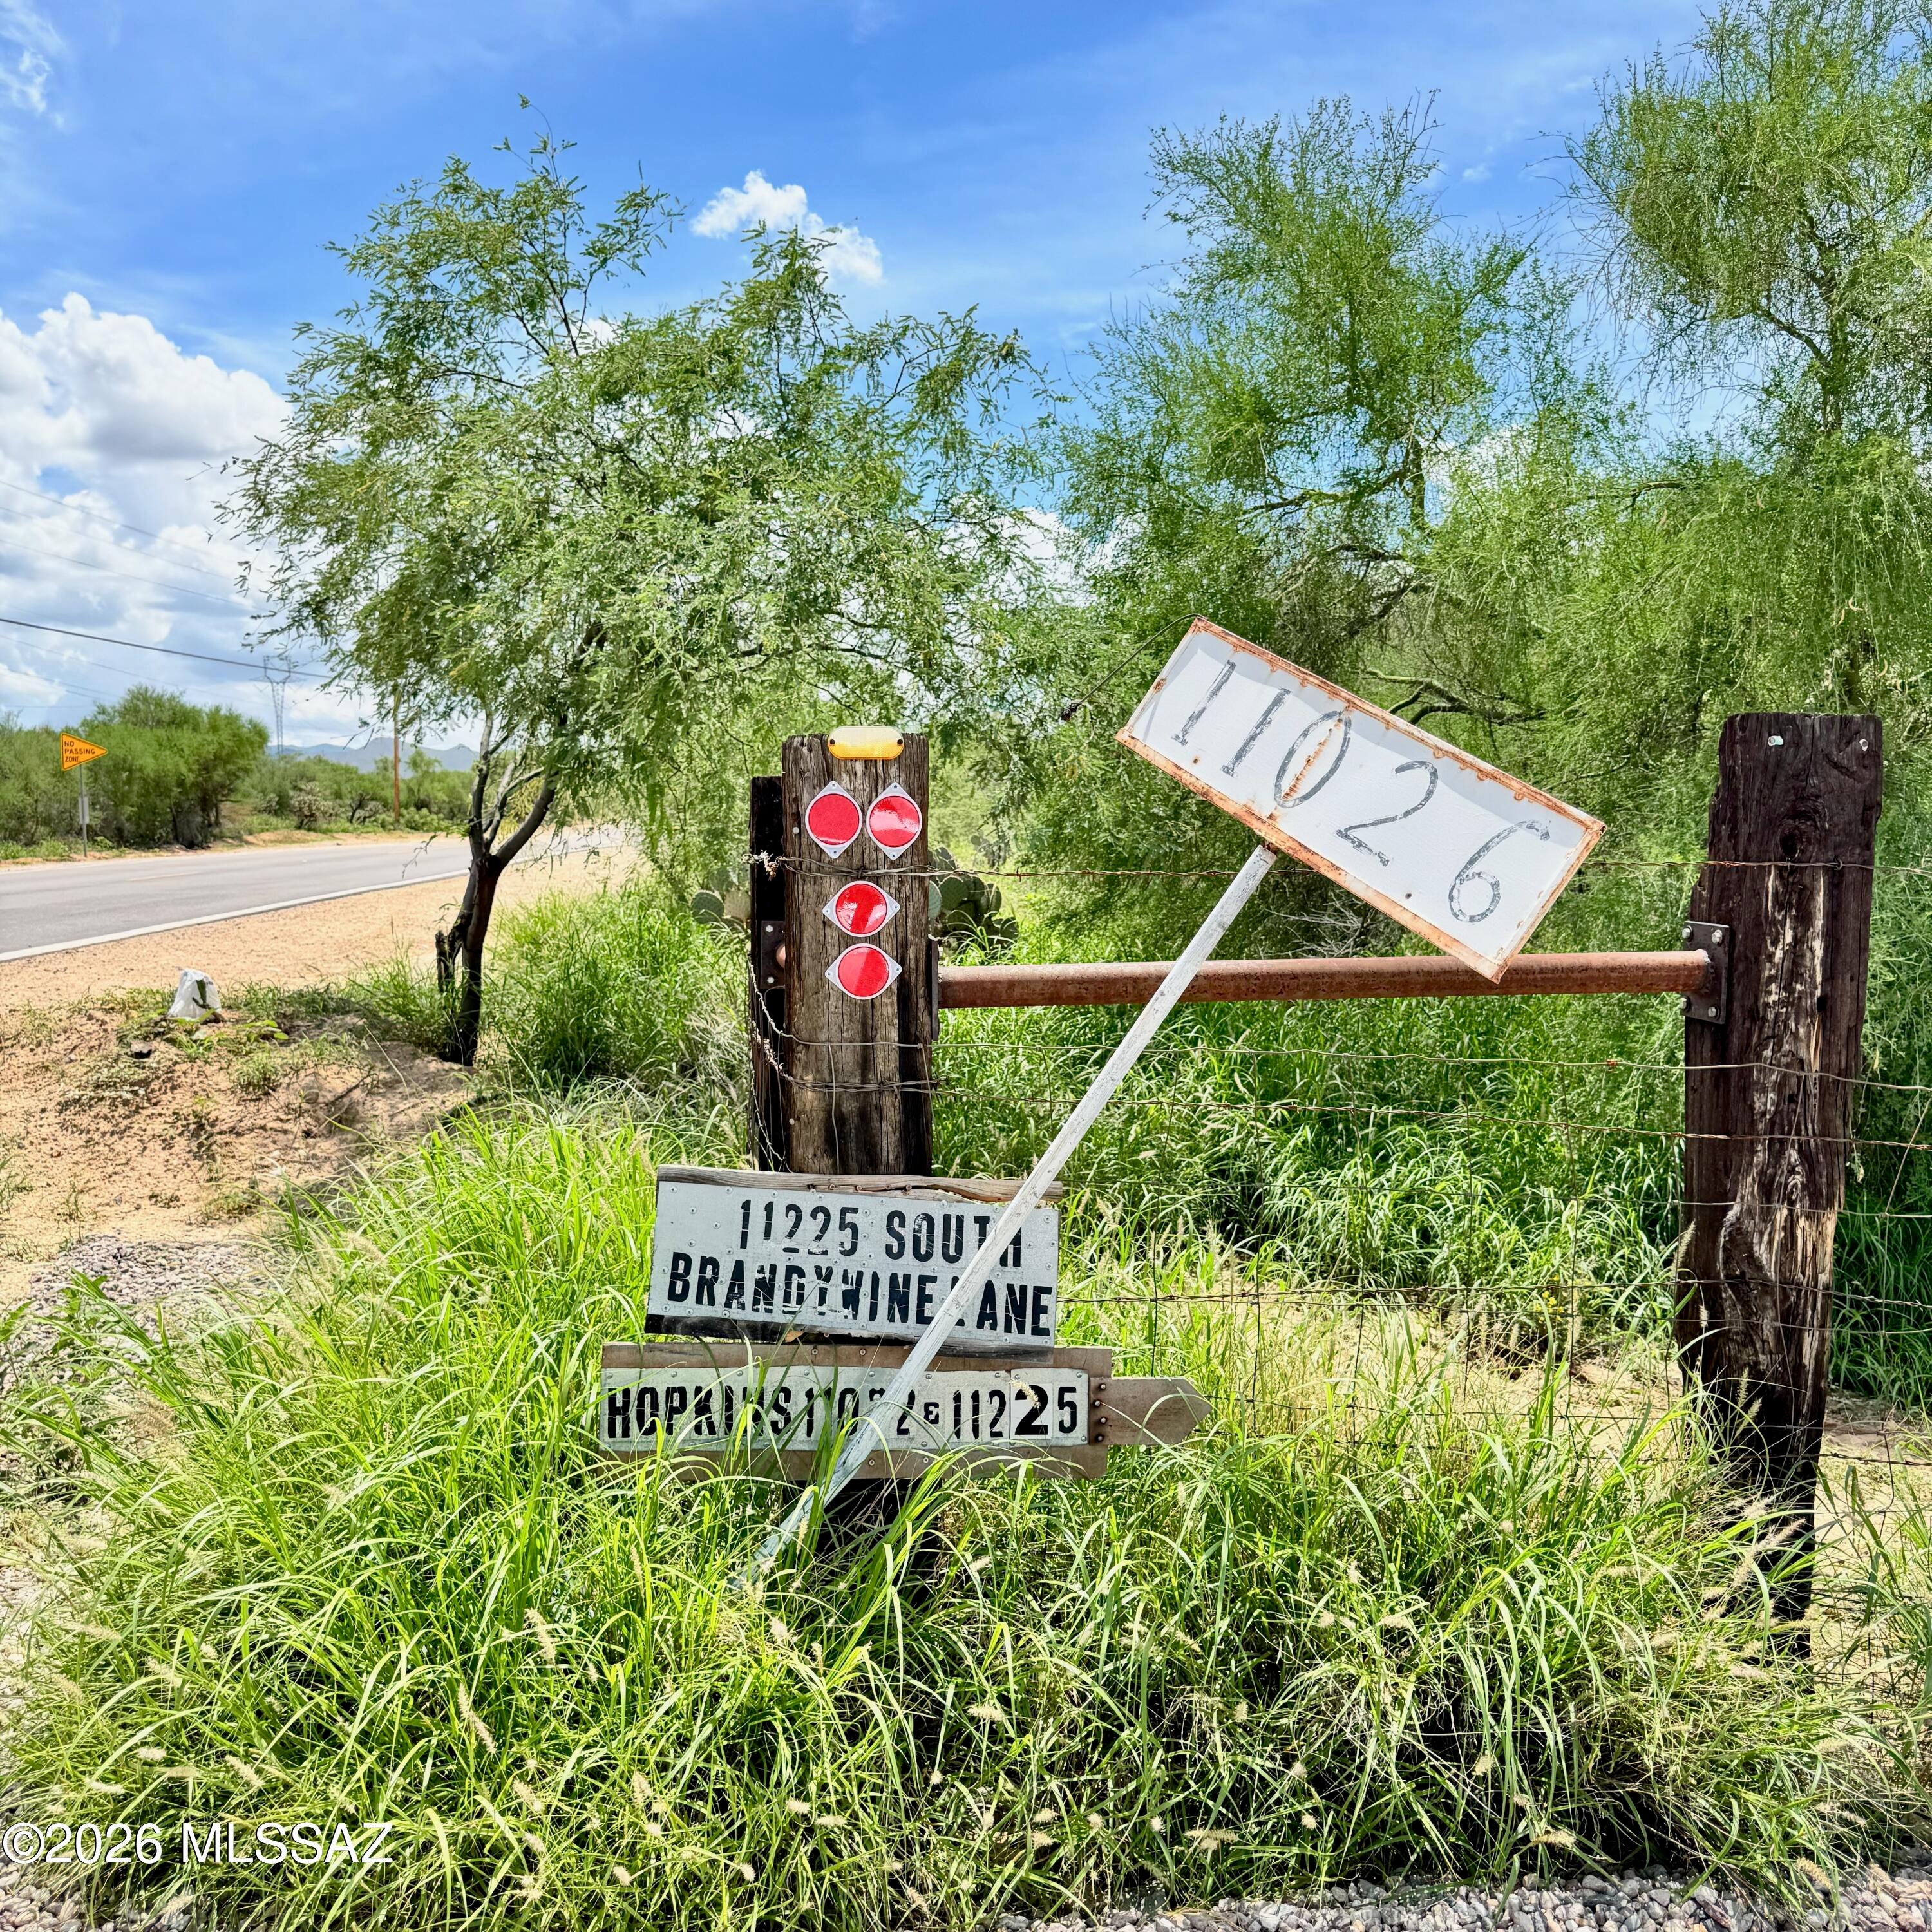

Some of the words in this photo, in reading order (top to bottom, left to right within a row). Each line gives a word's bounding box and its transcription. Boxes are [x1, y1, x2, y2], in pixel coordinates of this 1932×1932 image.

[1171, 659, 1551, 923] 11026
[739, 1198, 860, 1257] 11225
[667, 1251, 938, 1327] BRANDYWINE
[952, 1384, 1078, 1439] 11225
